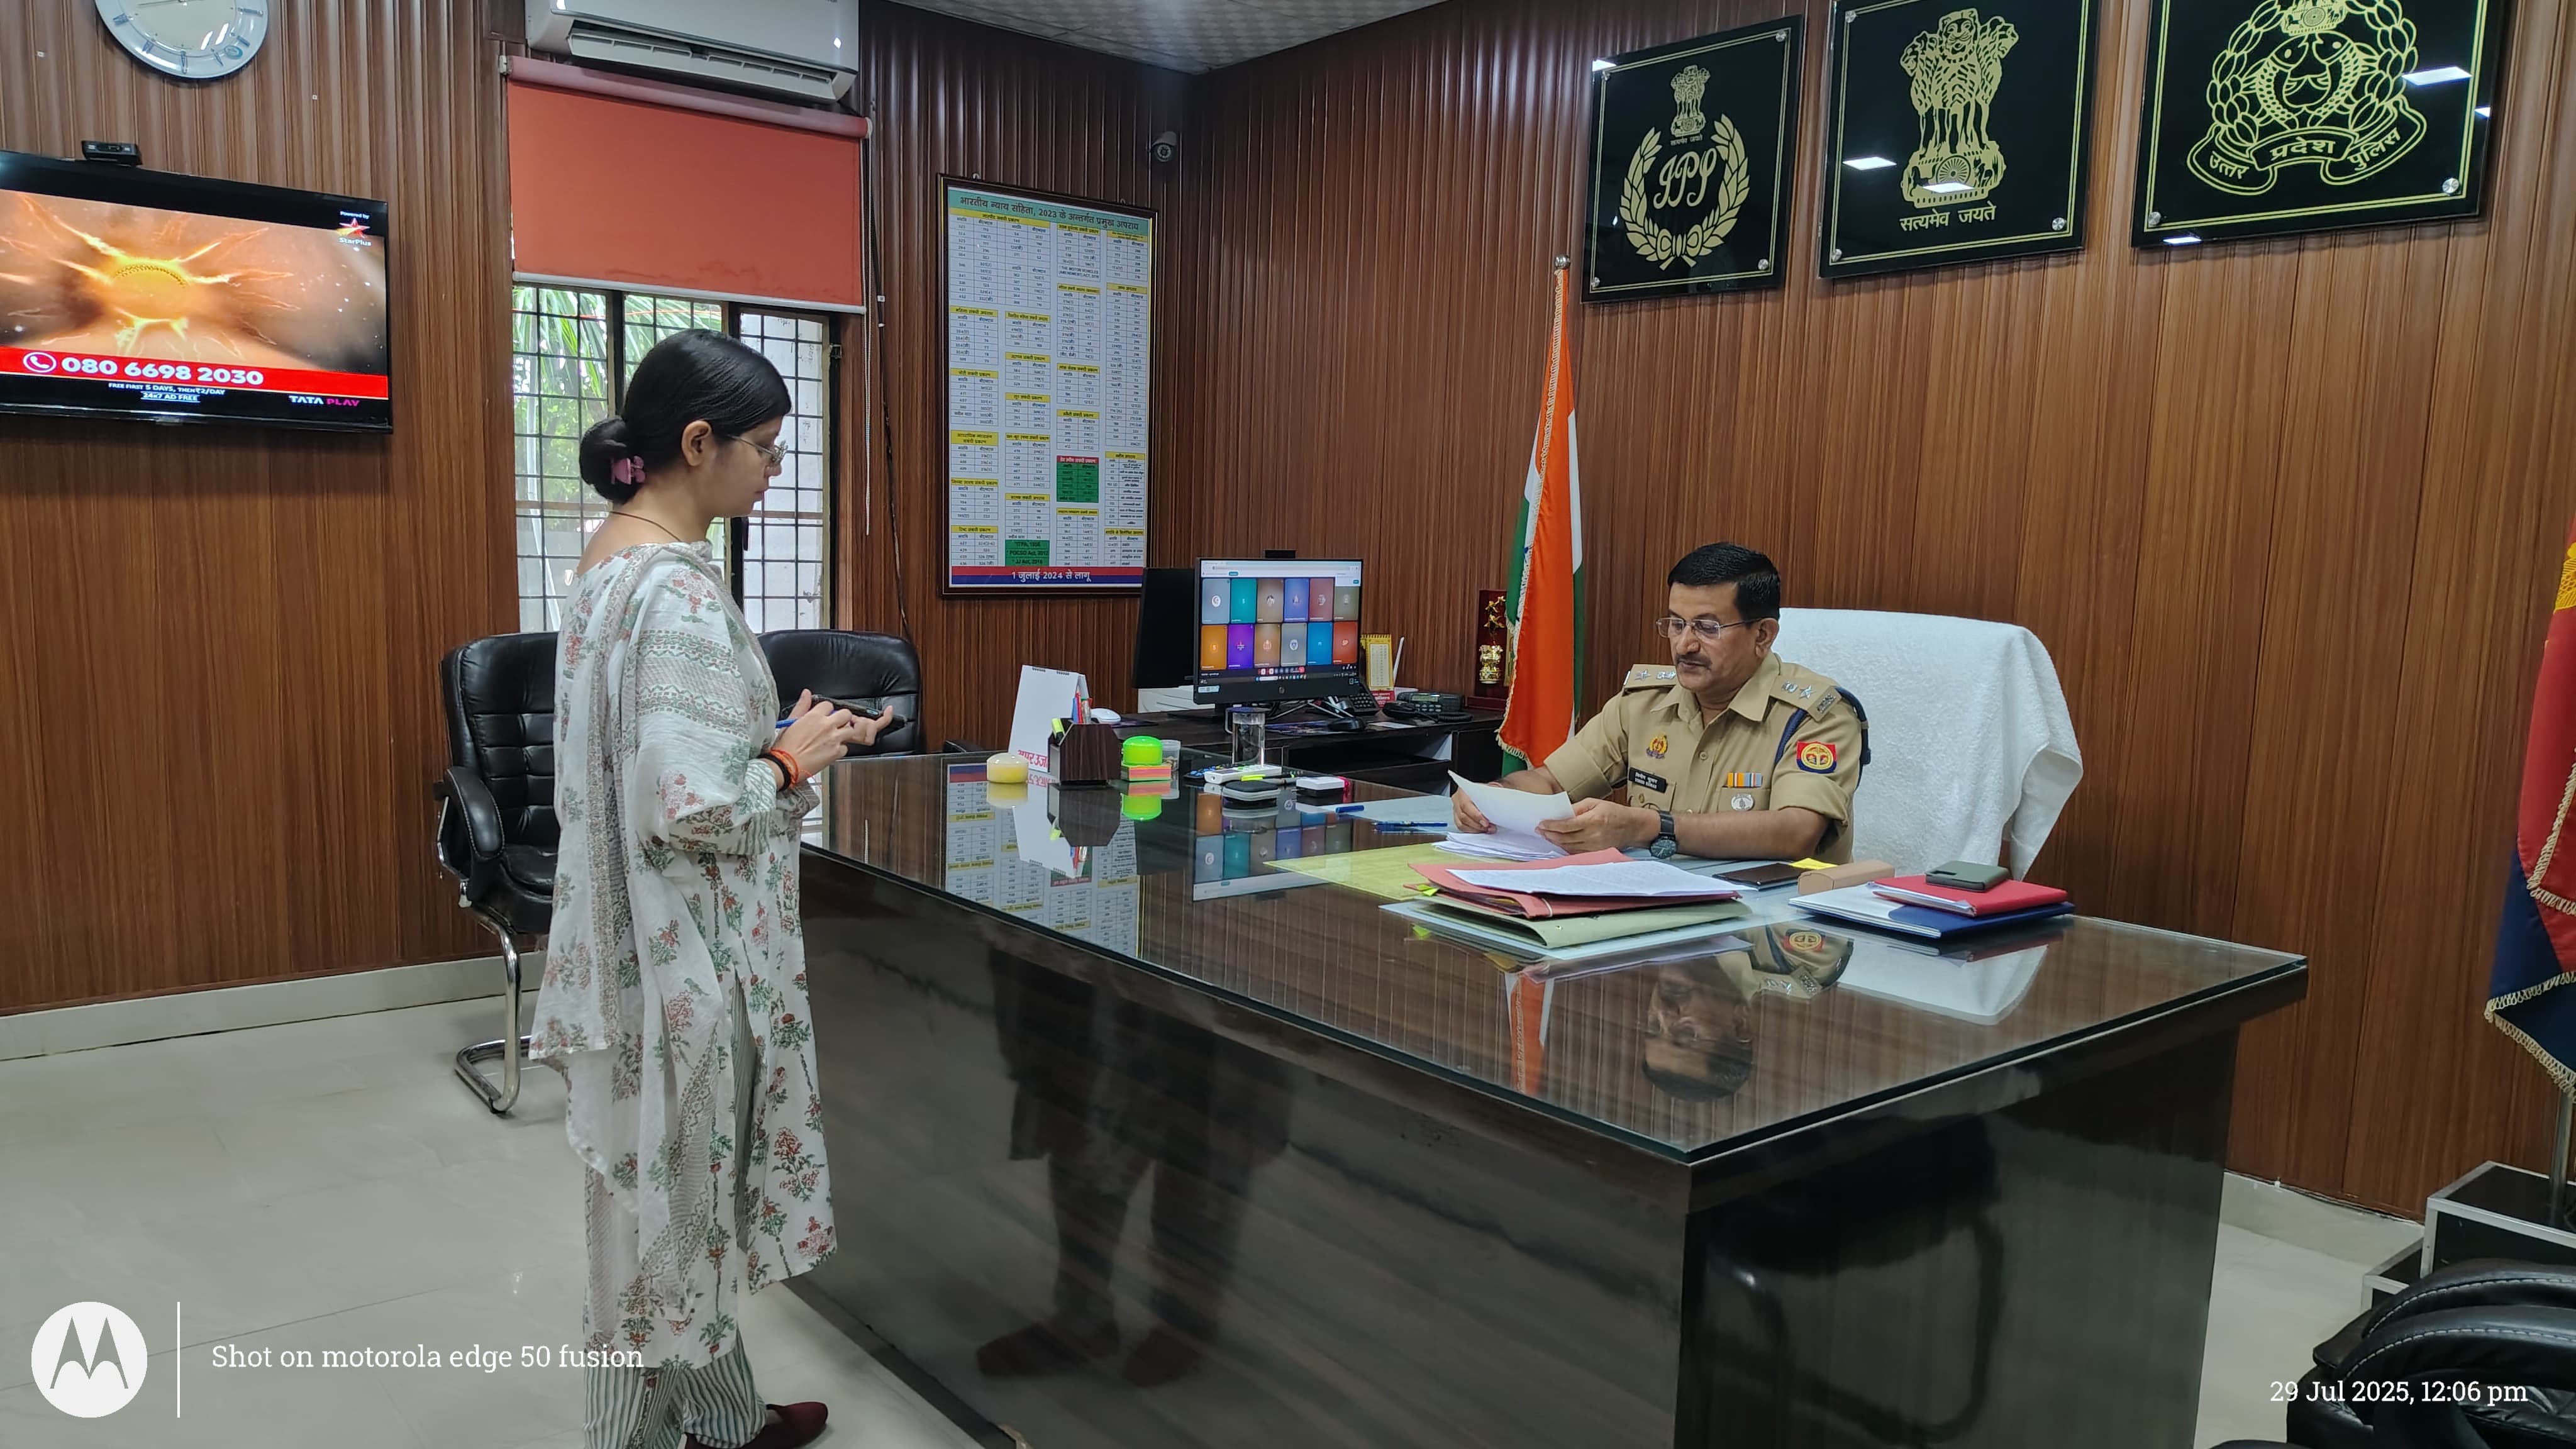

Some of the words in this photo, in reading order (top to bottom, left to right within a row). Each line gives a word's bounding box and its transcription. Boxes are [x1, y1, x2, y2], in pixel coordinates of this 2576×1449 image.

[2209, 150, 2249, 179] उत्तर
[2270, 136, 2335, 161] प्रदेश
[2347, 127, 2401, 170] पुलिस
[960, 196, 988, 208] भारतीय
[991, 201, 1009, 211] न्याय
[1011, 202, 1036, 216] संहिता,
[1039, 208, 1057, 218] 2023
[1058, 209, 1066, 219] के
[1069, 212, 1094, 224] अन्तर्गत
[1096, 217, 1114, 228] प्रमुख
[1899, 209, 1950, 231] सत्यमेव
[1958, 201, 1996, 223] जयते
[340, 238, 371, 246] StarPlus
[62, 357, 118, 375] 080
[125, 362, 191, 380] 6698
[197, 367, 264, 385] 2030
[289, 396, 324, 404] TATA
[1018, 567, 1040, 582] जुलाई
[1065, 568, 1074, 579] से
[1075, 572, 1092, 582] लागू
